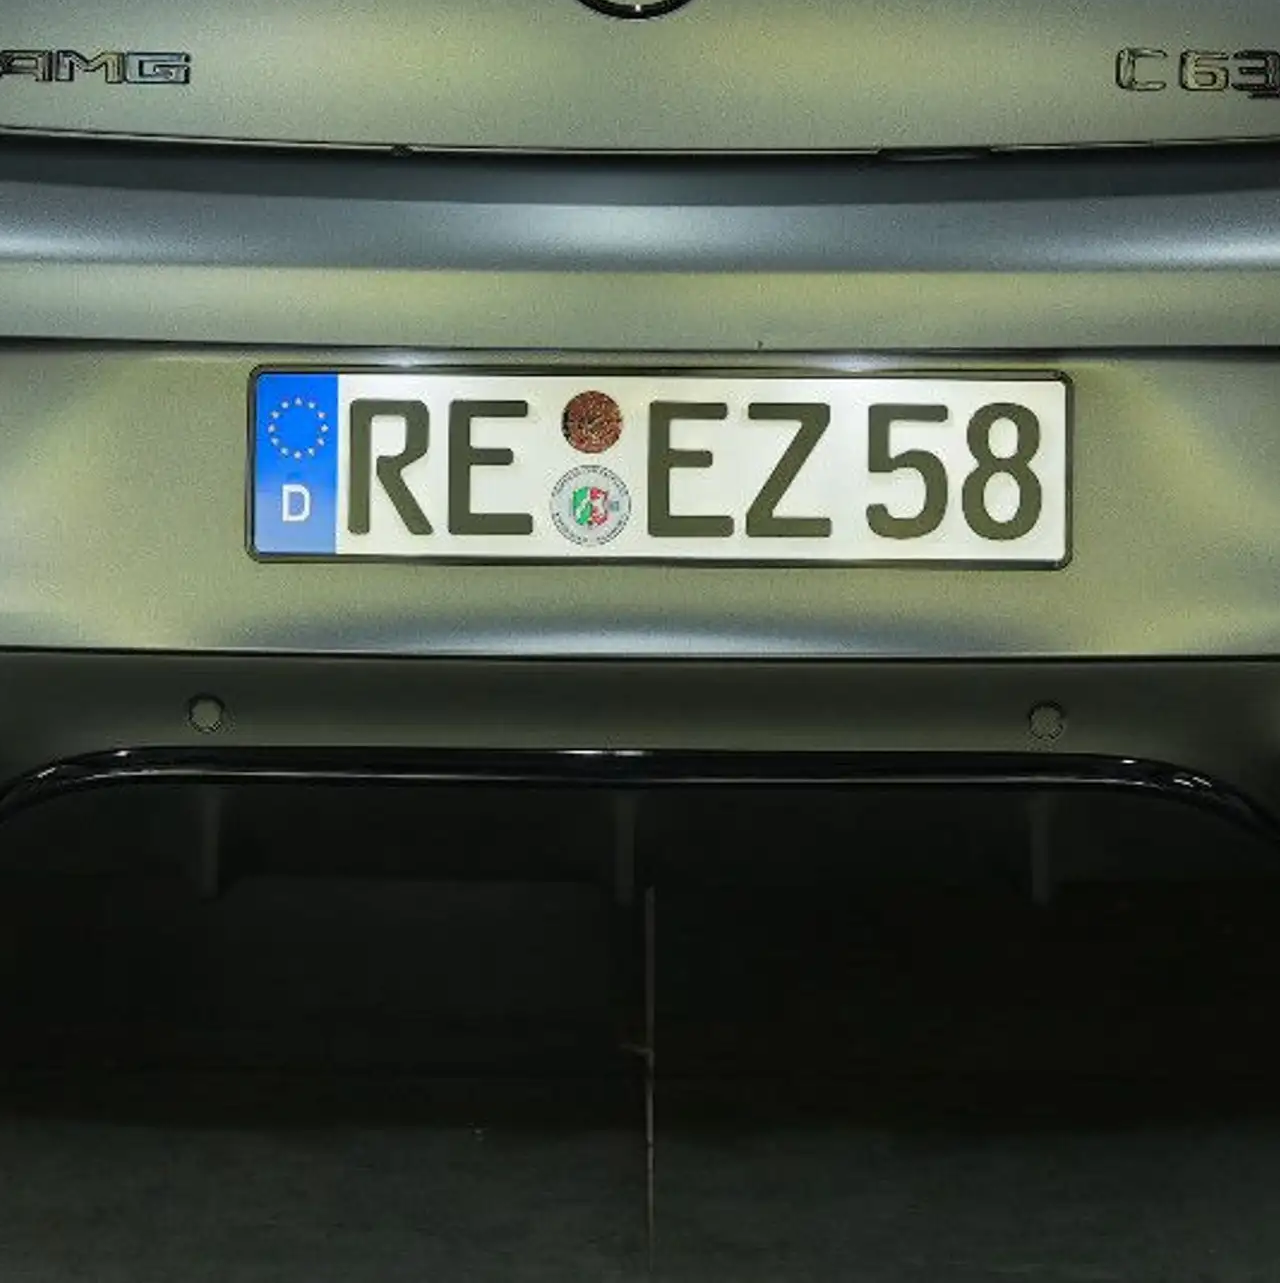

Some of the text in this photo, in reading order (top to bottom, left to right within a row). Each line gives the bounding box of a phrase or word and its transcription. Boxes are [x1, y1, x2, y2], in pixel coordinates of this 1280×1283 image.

[282, 484, 311, 522] D
[347, 399, 534, 537] RE
[647, 401, 833, 539] EZ
[865, 403, 1044, 542] 58
